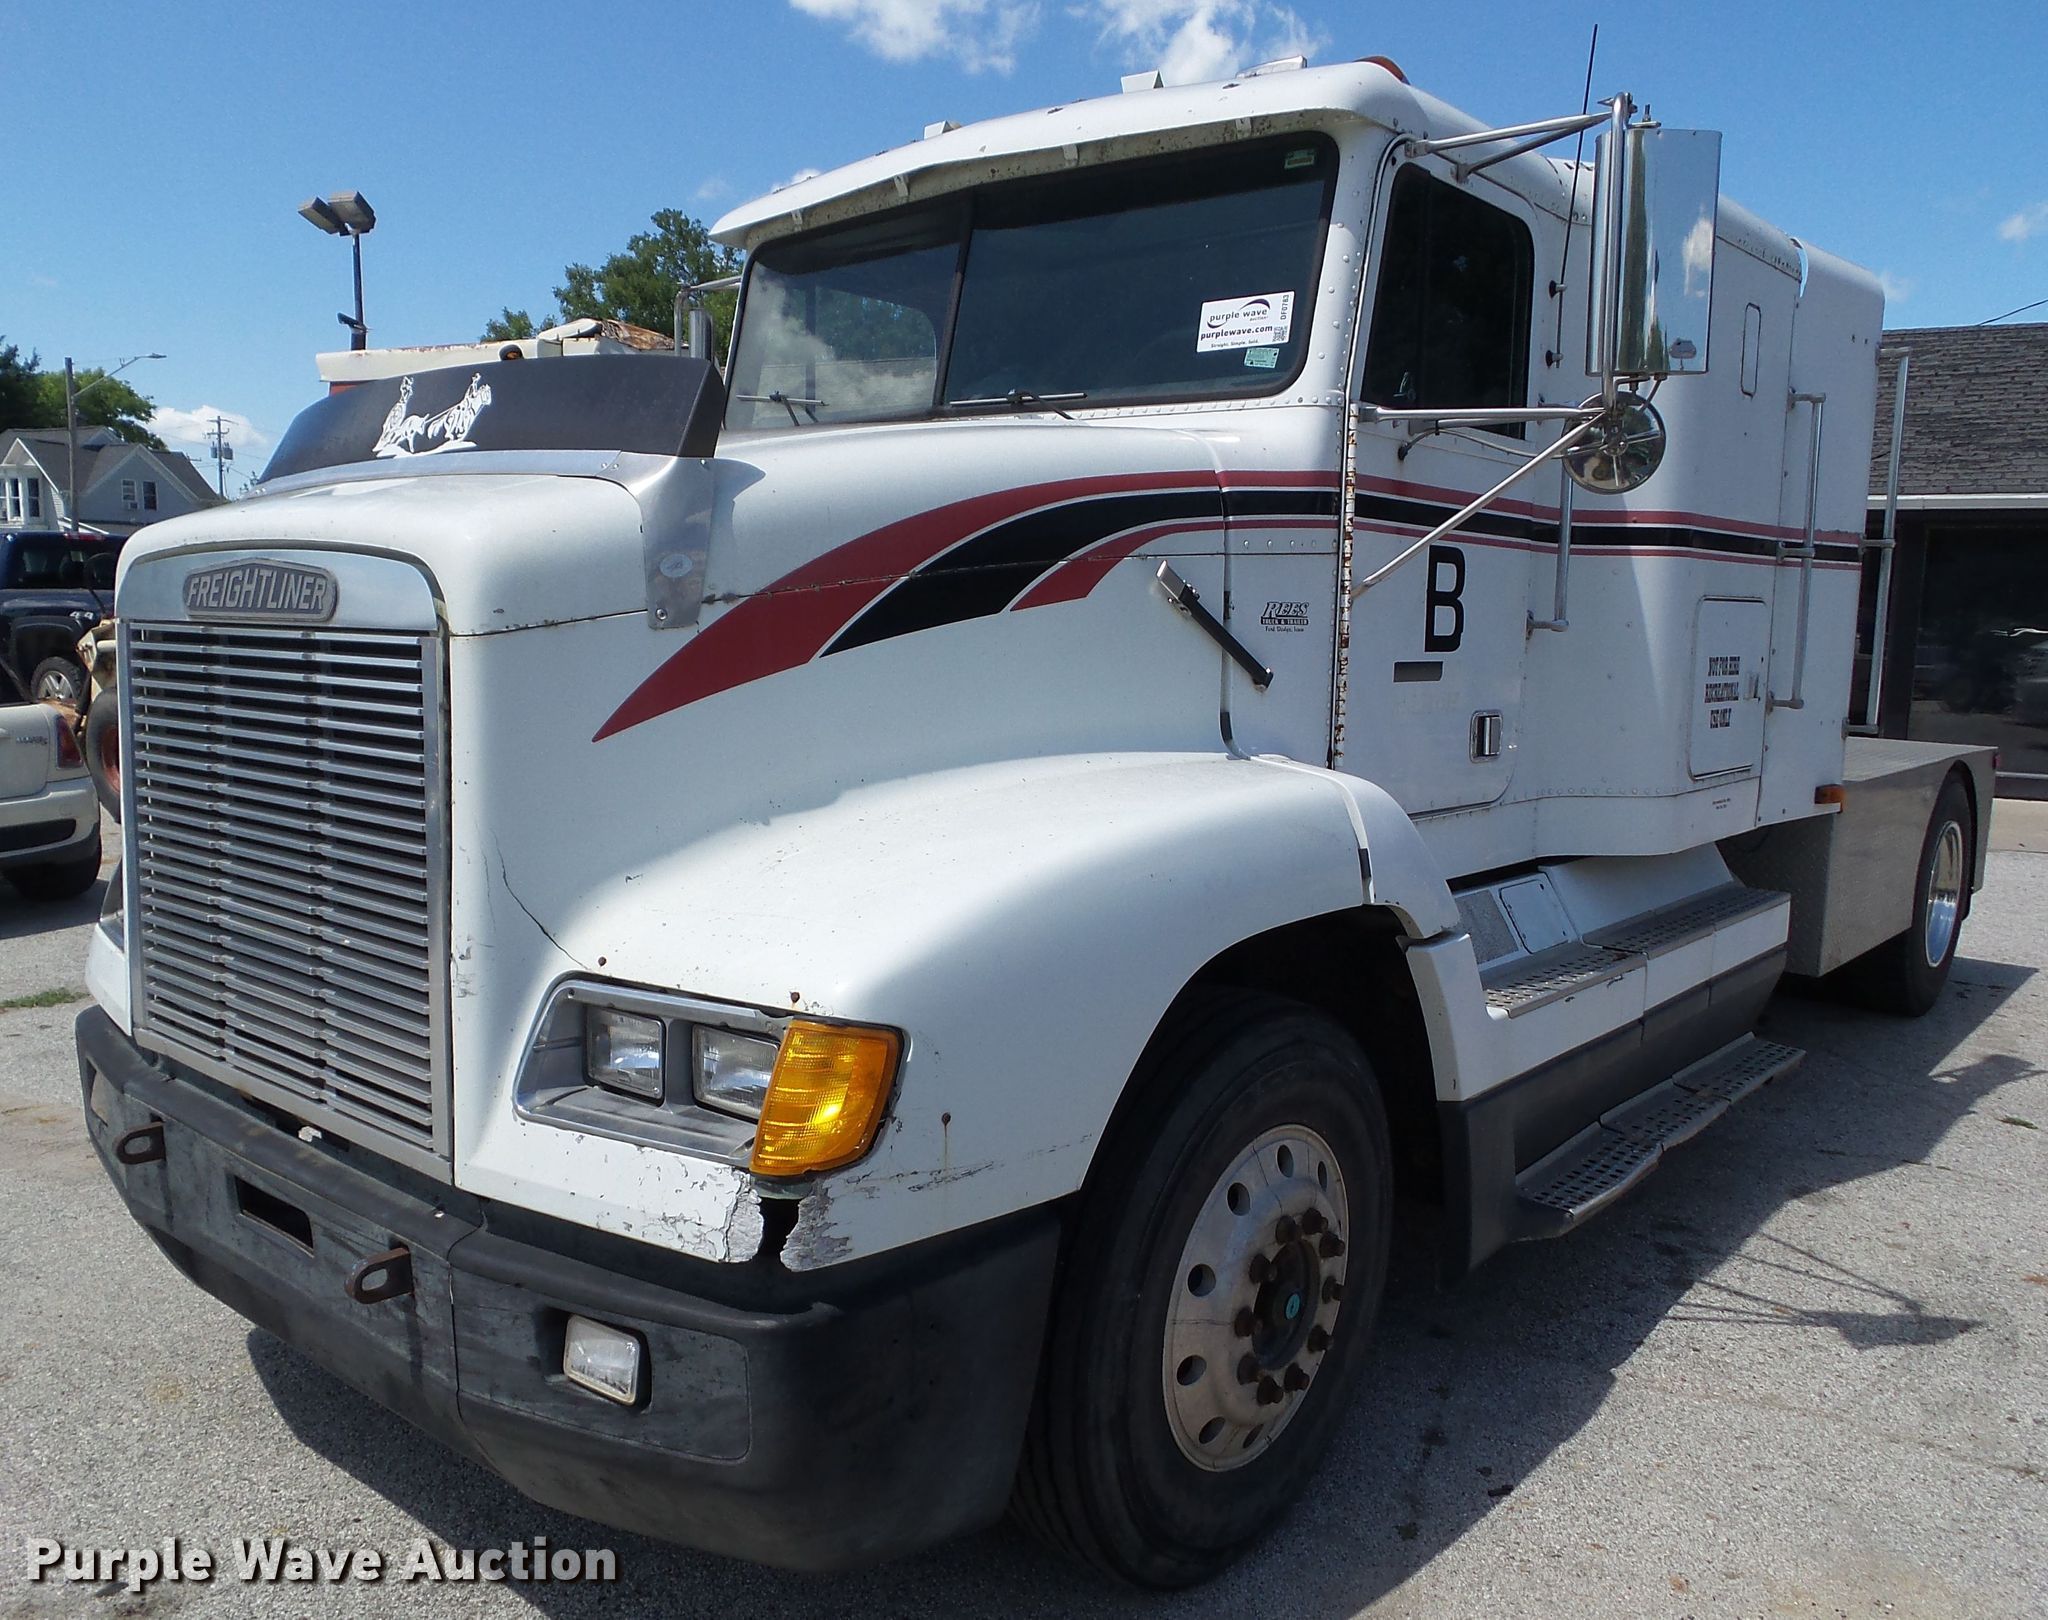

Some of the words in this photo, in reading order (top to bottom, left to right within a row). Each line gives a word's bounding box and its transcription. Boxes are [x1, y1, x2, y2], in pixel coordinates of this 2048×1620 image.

[1209, 312, 1240, 322] purple
[1243, 308, 1268, 318] wave
[1200, 325, 1273, 341] purplewave.com
[186, 568, 328, 610] FREIGHTLINER
[1424, 544, 1466, 653] B
[1263, 602, 1310, 618] REES
